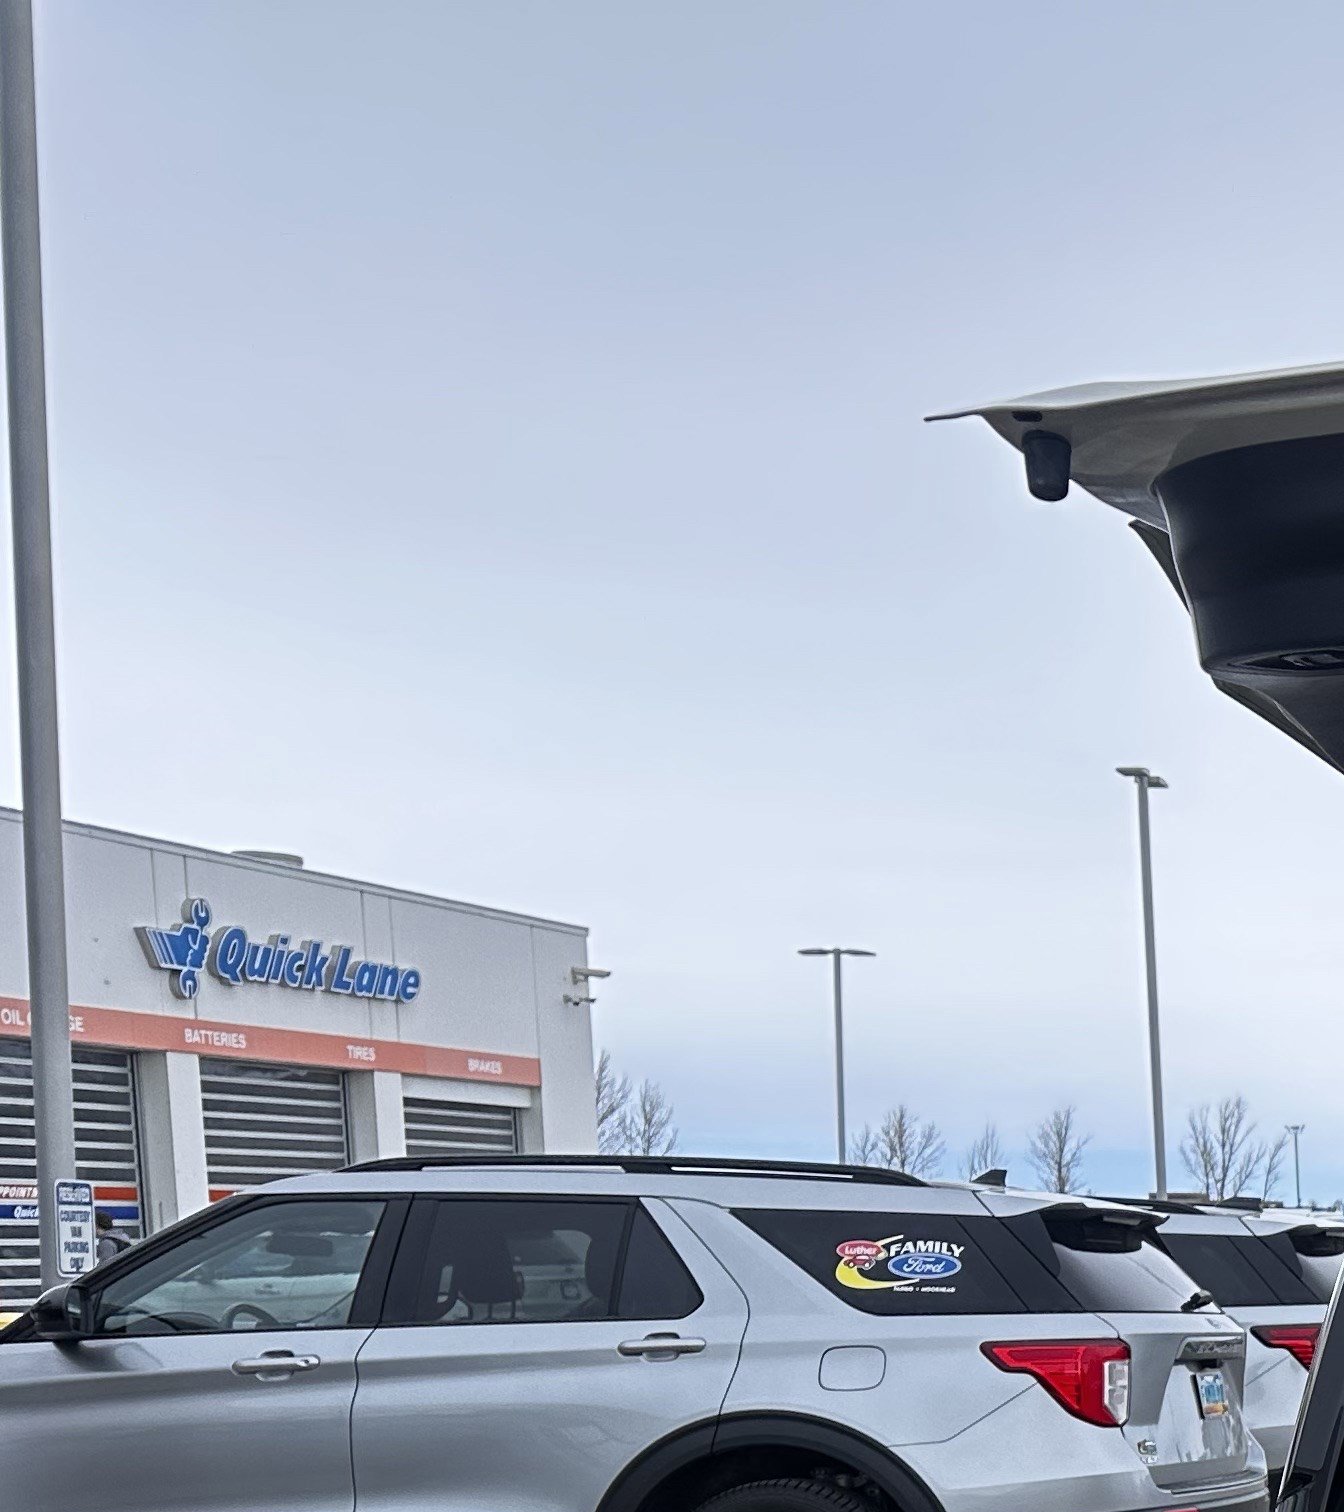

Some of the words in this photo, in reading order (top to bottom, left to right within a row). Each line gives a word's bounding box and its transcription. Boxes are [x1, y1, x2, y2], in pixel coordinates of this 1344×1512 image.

[216, 926, 331, 990] Quick
[330, 944, 421, 1004] Lane
[1, 1008, 26, 1026] OIL
[184, 1028, 247, 1049] BATTERIES
[346, 1044, 376, 1062] TIRES
[467, 1057, 503, 1075] BRAKES
[844, 1246, 877, 1255] Luther
[889, 1240, 964, 1257] FAMILY
[902, 1257, 946, 1273] Ford
